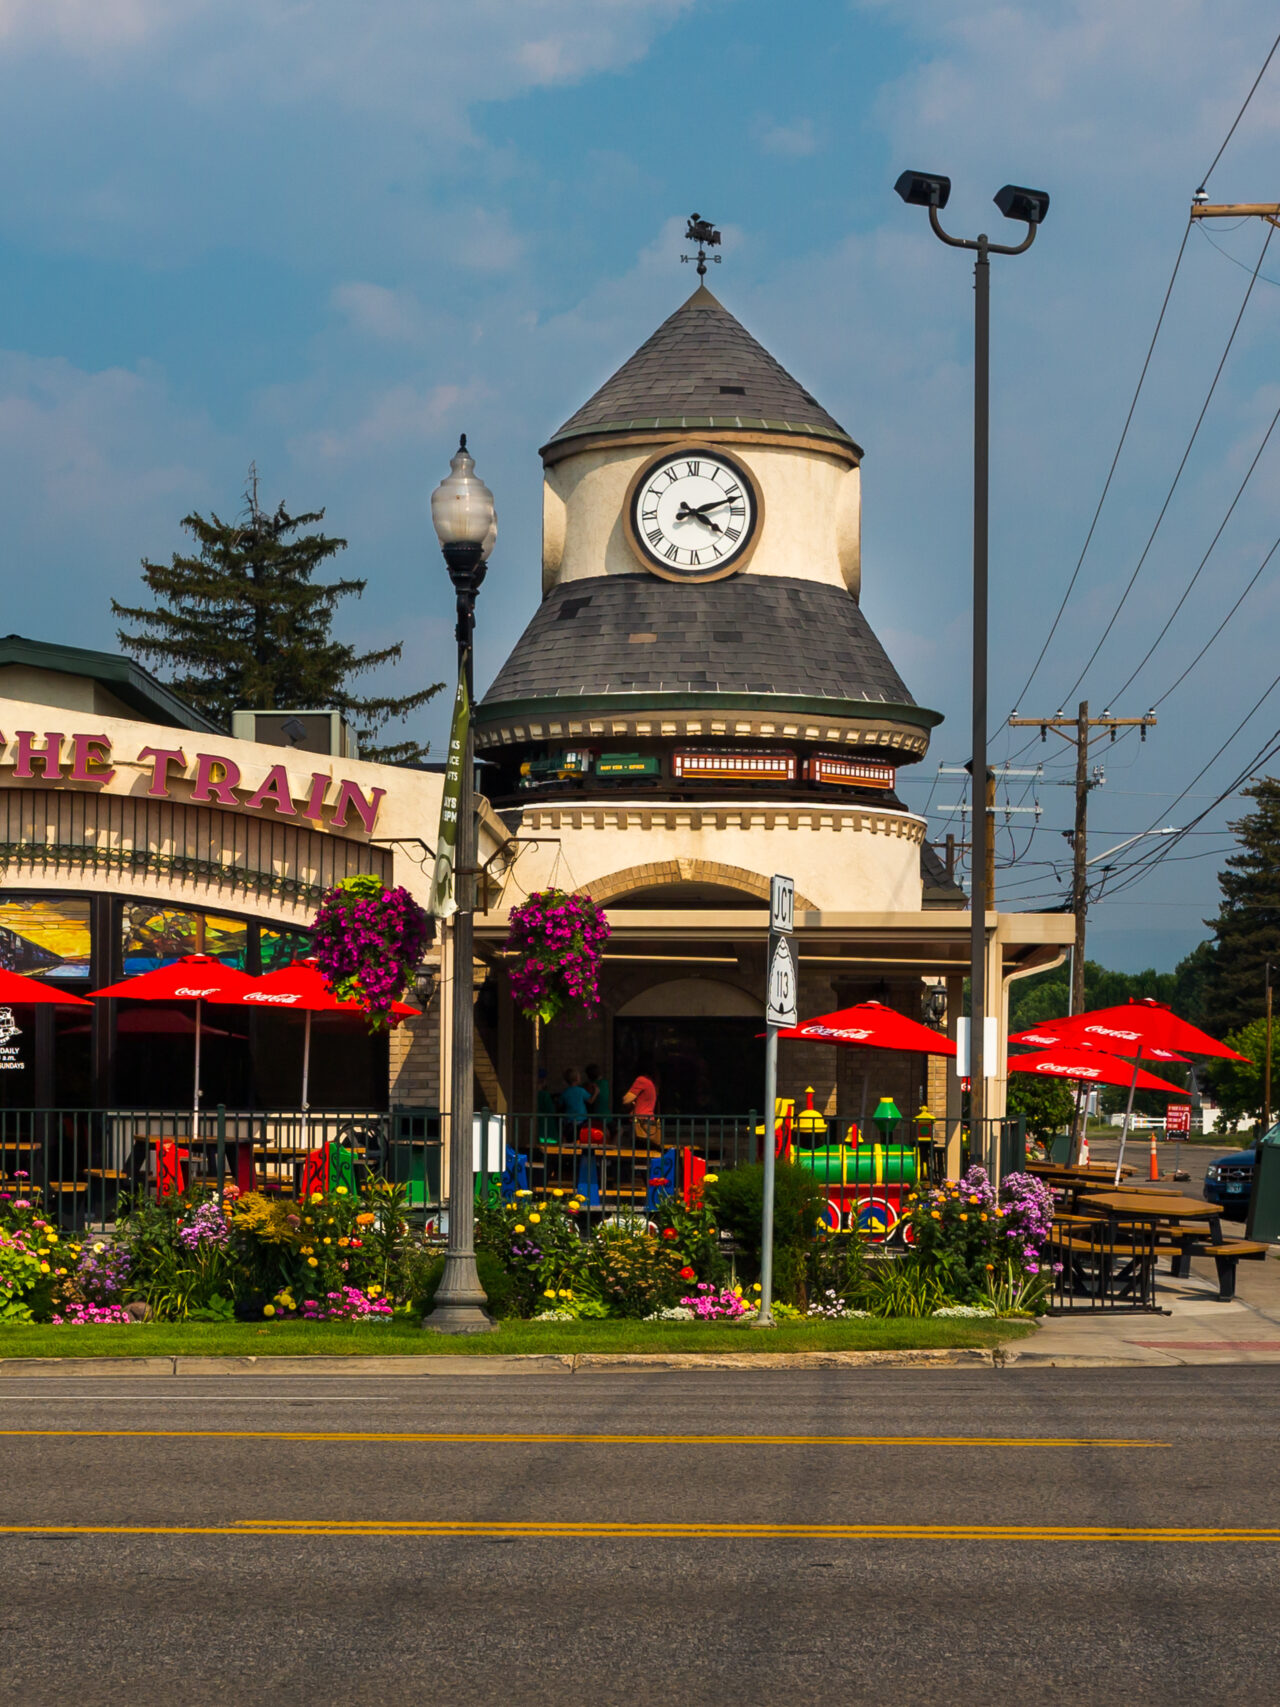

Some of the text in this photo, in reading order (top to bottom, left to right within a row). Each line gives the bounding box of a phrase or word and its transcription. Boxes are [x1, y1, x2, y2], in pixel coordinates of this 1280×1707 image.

[136, 745, 388, 834] TRAIN
[774, 885, 793, 923] JCT
[776, 970, 789, 999] 113
